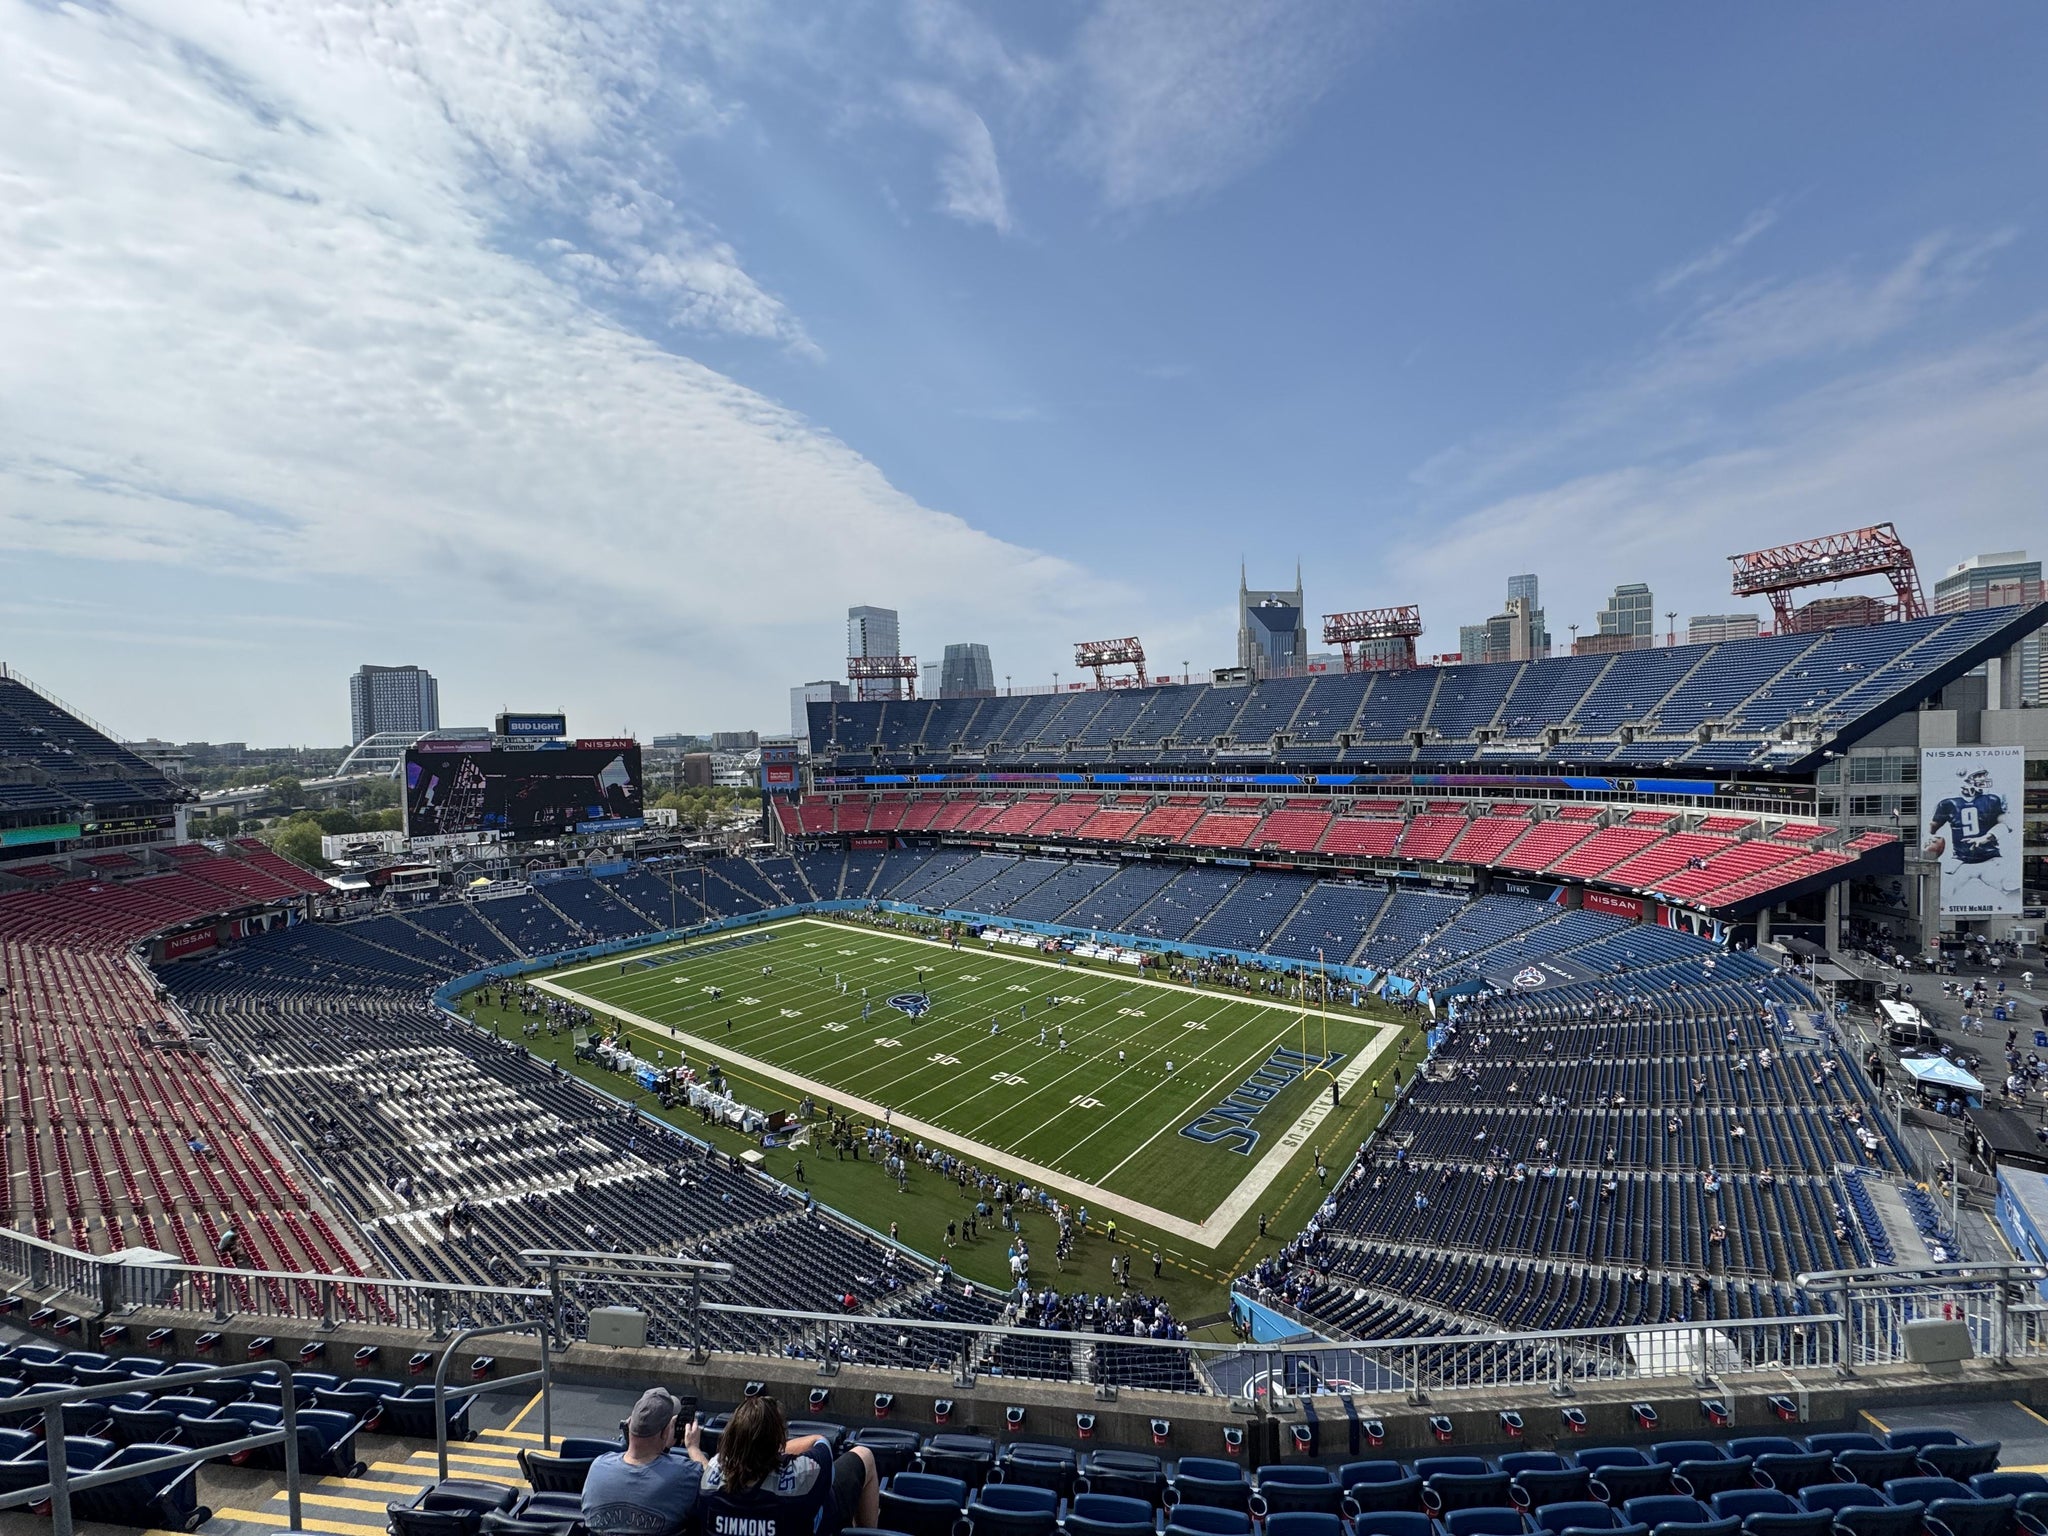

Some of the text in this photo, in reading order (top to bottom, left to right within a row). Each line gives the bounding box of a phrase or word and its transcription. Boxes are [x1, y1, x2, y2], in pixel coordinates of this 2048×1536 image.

[511, 722, 560, 731] BUD LIGHT
[504, 742, 535, 751] Pinnacle
[1975, 749, 2020, 757] STADIUM
[1960, 806, 1980, 837] 9
[341, 833, 393, 843] NISSAN
[413, 836, 435, 844] MARS
[1590, 895, 1636, 910] NISSAN
[172, 931, 211, 949] NISSAN
[820, 1021, 849, 1032] 50
[873, 1037, 899, 1048] 40
[926, 1052, 956, 1067] 30
[989, 1071, 1022, 1086] 20
[1069, 1094, 1099, 1109] 10
[1307, 1099, 1333, 1116] ALL
[1297, 1118, 1316, 1132] OF
[1281, 1132, 1305, 1148] US
[715, 1515, 776, 1536] SIMMONS
